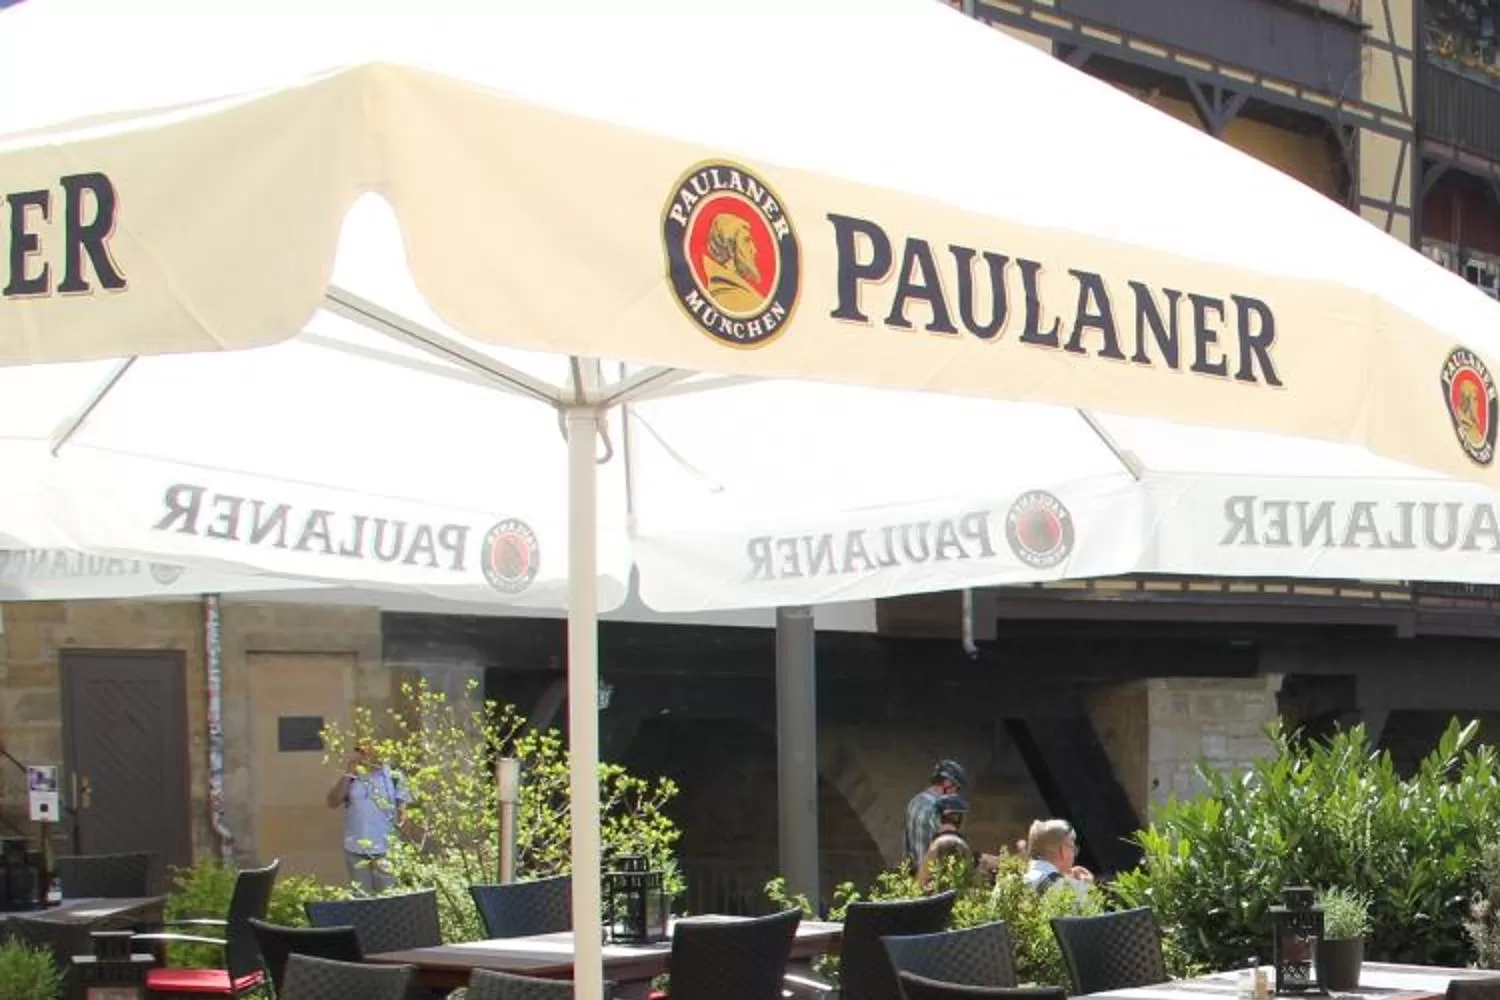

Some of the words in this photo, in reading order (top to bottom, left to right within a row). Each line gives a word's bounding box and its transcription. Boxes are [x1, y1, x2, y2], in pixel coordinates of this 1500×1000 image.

[2, 172, 127, 297] ER
[670, 168, 790, 241] PAULANER
[826, 212, 1284, 387] PAULANER
